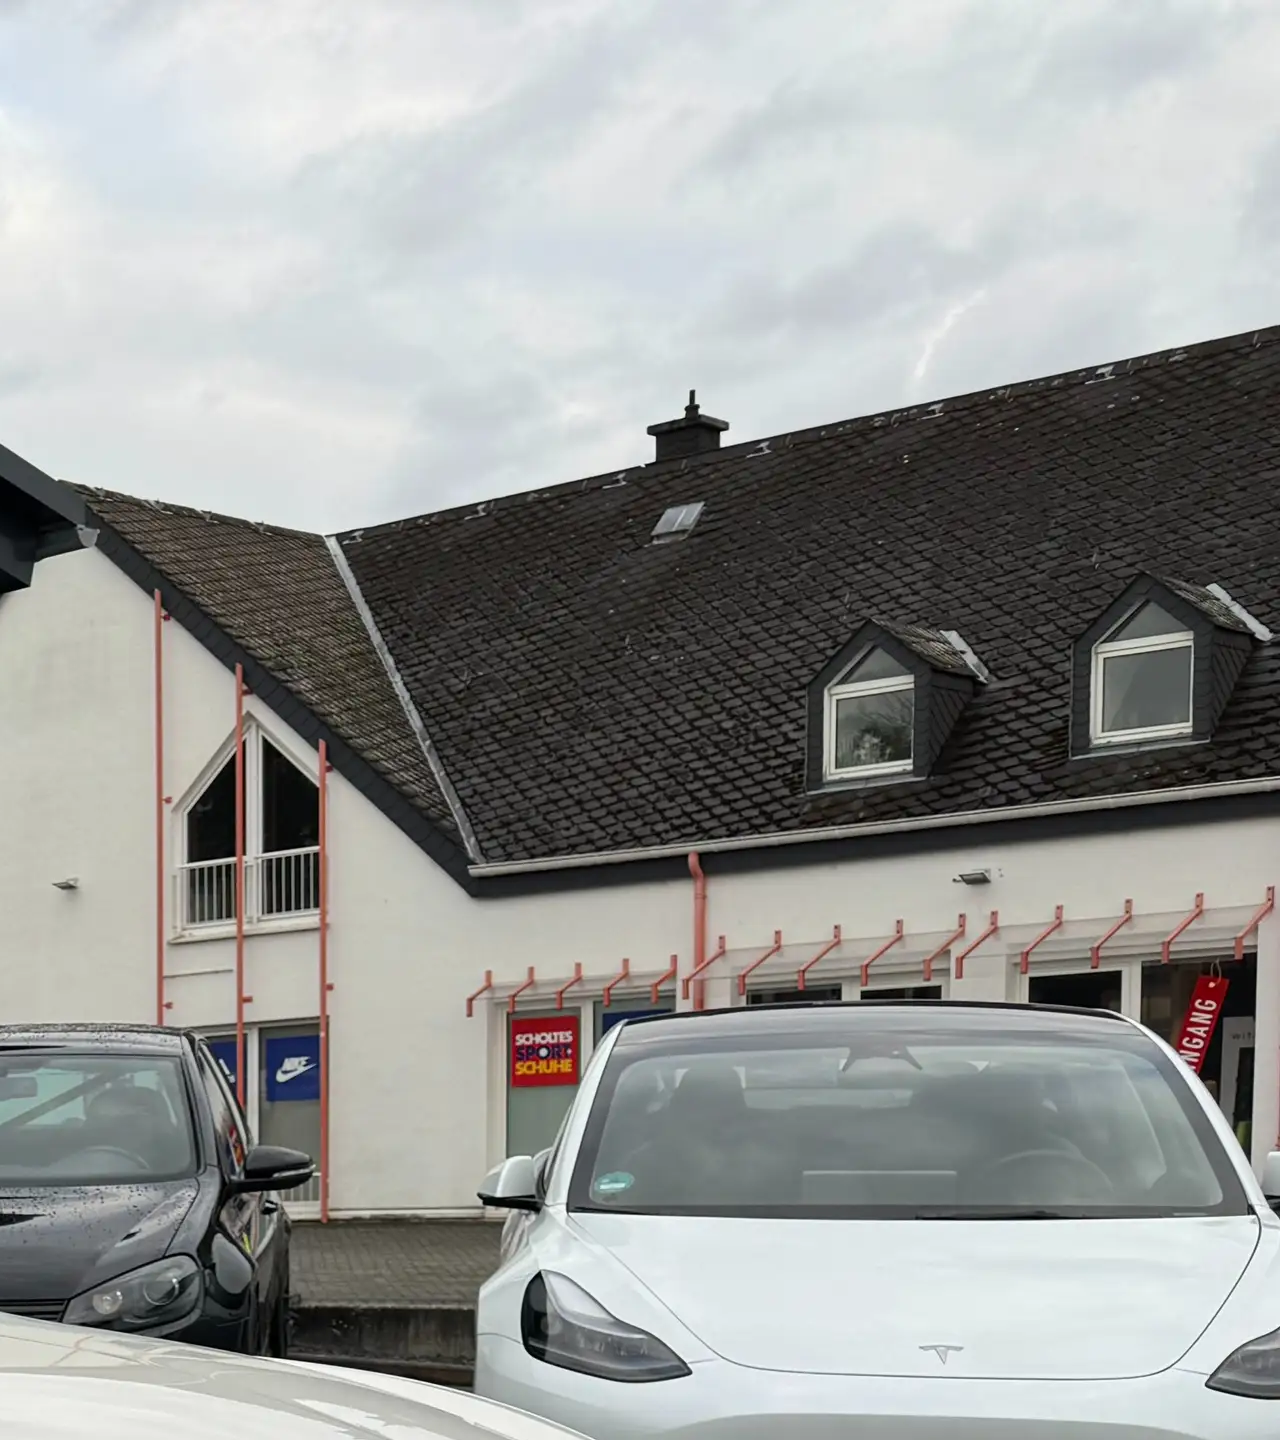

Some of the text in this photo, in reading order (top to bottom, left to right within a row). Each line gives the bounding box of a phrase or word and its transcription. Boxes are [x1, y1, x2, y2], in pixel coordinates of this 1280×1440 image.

[515, 1030, 573, 1045] SCHOLTES
[1179, 998, 1217, 1069] NGANG
[281, 1056, 311, 1071] NIKE
[515, 1059, 573, 1075] SCHUHE
